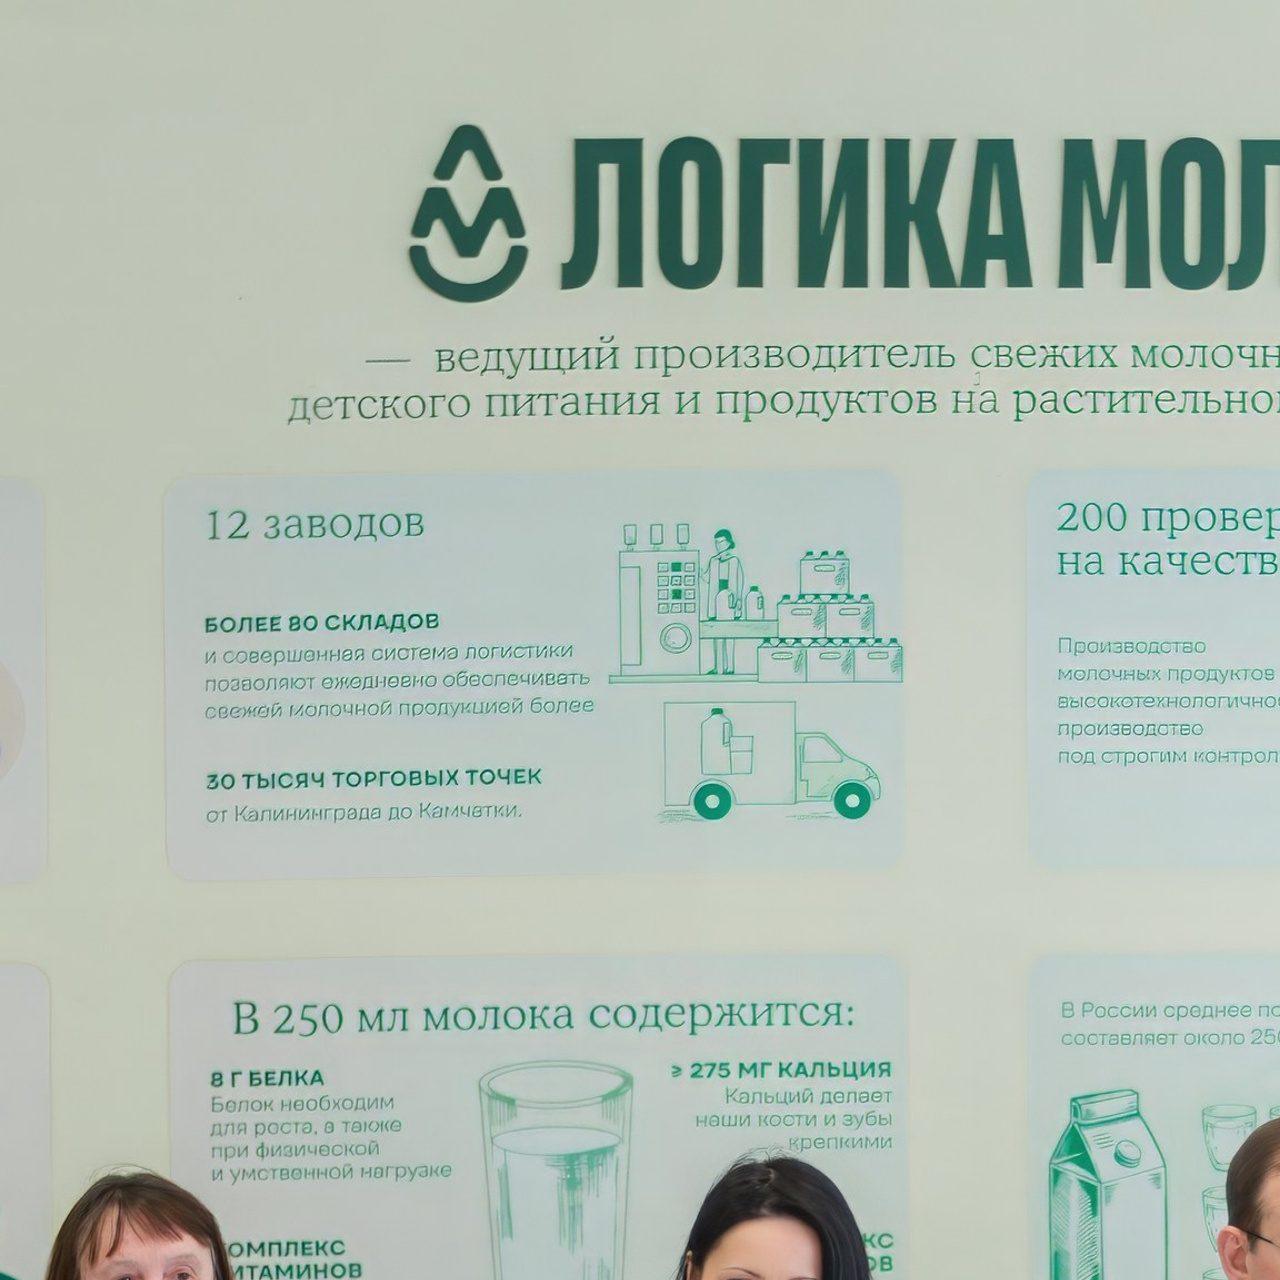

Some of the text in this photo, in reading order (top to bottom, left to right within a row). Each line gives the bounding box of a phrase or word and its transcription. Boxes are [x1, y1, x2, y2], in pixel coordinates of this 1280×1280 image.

[560, 136, 1033, 290] ЛОГИКА
[436, 335, 619, 380] ведущий
[635, 344, 955, 378] производитель
[971, 344, 1118, 375] свежих
[288, 395, 470, 425] детского
[486, 392, 660, 417] питания
[675, 391, 700, 415] и
[717, 389, 936, 423] продуктов
[952, 383, 999, 414] на
[208, 510, 424, 542] 12 заводов
[1057, 502, 1127, 531] 200
[1058, 552, 1104, 575] на
[205, 613, 439, 633] БОЛЕЕ 80 СКЛАДОВ
[205, 645, 573, 667] и совершенная система логистики
[1059, 637, 1206, 656] Производство
[206, 671, 590, 692] позволяют ежедневно обеспечивать
[1058, 668, 1275, 684] молочных продуктов
[205, 697, 594, 719] свежей молочной продукцией более
[1058, 723, 1203, 740] производство
[1059, 751, 1096, 765] под
[1101, 751, 1186, 767] строгим
[207, 768, 541, 790] 30 ТЫСЯЧ ТОРГОВЫХ ТОЧЕК
[207, 802, 521, 824] от Калининграда до Камчатки.
[234, 1000, 853, 1038] В 250 мл молока содержится:
[1062, 1002, 1075, 1019] В
[1082, 1002, 1157, 1019] России
[1164, 1004, 1252, 1022] среднее
[1062, 1034, 1178, 1046] составляет
[1185, 1033, 1244, 1046] около
[231, 1071, 242, 1088] Г
[249, 1069, 324, 1087] БЕЛКА
[690, 1062, 730, 1078] 275
[739, 1062, 772, 1078] МГ
[779, 1061, 891, 1080] КАЛЬЦИЯ
[212, 1094, 394, 1113] Белок необходим
[726, 1086, 892, 1105] Кальций делает
[210, 1119, 402, 1139] для роста, а также
[696, 1110, 892, 1130] наши кости и зубы
[212, 1140, 379, 1161] при физической
[787, 1136, 893, 1153] крепкими
[212, 1162, 452, 1186] и умственной нагрузке
[225, 1240, 346, 1258] ОМПЛЕКС
[232, 1263, 362, 1280] ИТАМИНОВ
